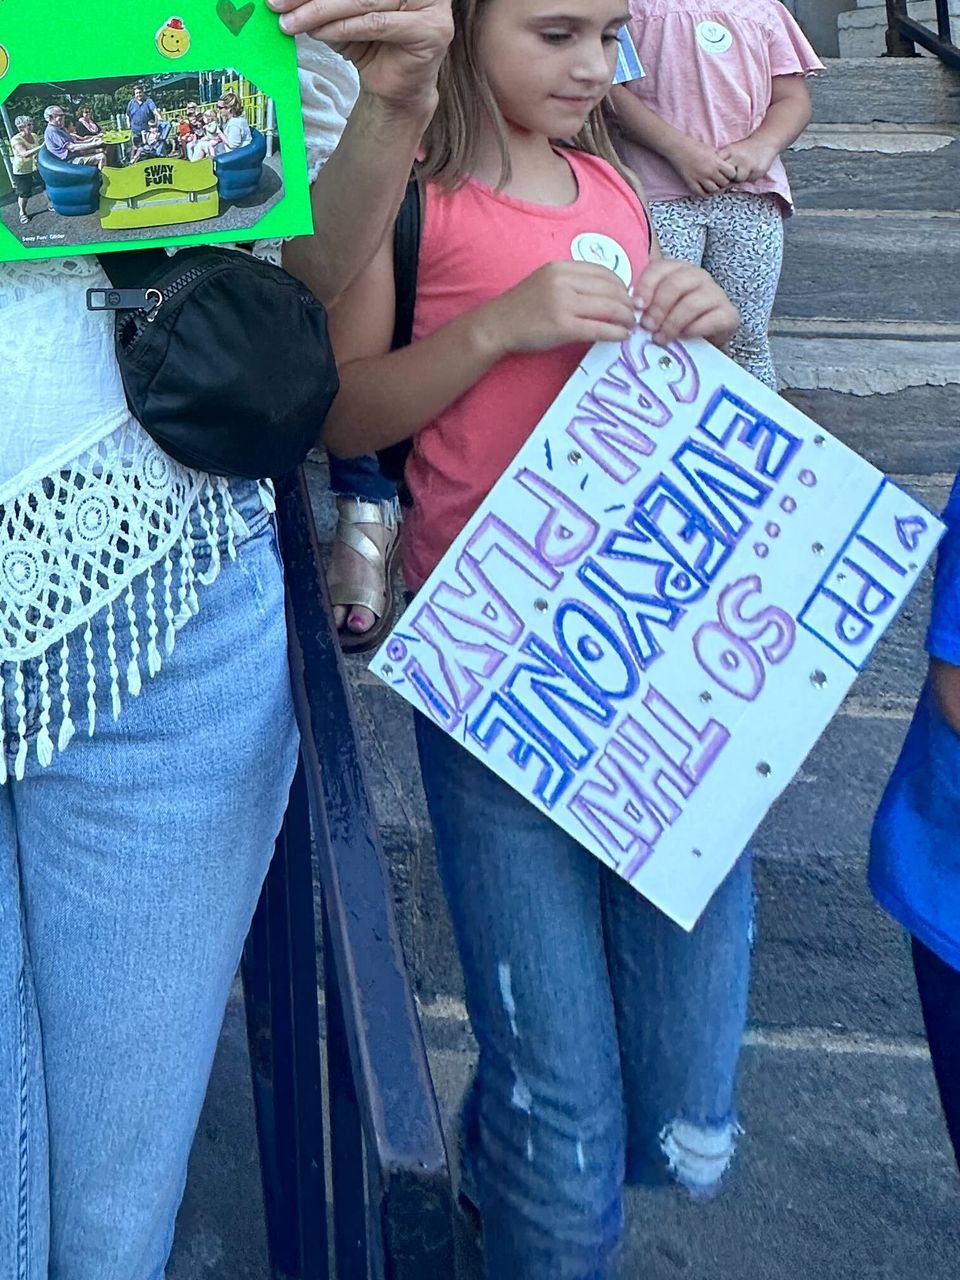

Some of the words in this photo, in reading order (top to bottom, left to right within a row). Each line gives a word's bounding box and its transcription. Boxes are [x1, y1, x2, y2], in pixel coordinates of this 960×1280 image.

[144, 164, 174, 177] SWAY
[145, 173, 173, 187] FUN
[566, 334, 700, 485] CAN
[386, 467, 598, 733] PLAY!
[464, 384, 803, 810] EVERYONE
[821, 533, 908, 646] IPP
[566, 683, 731, 881] THAT
